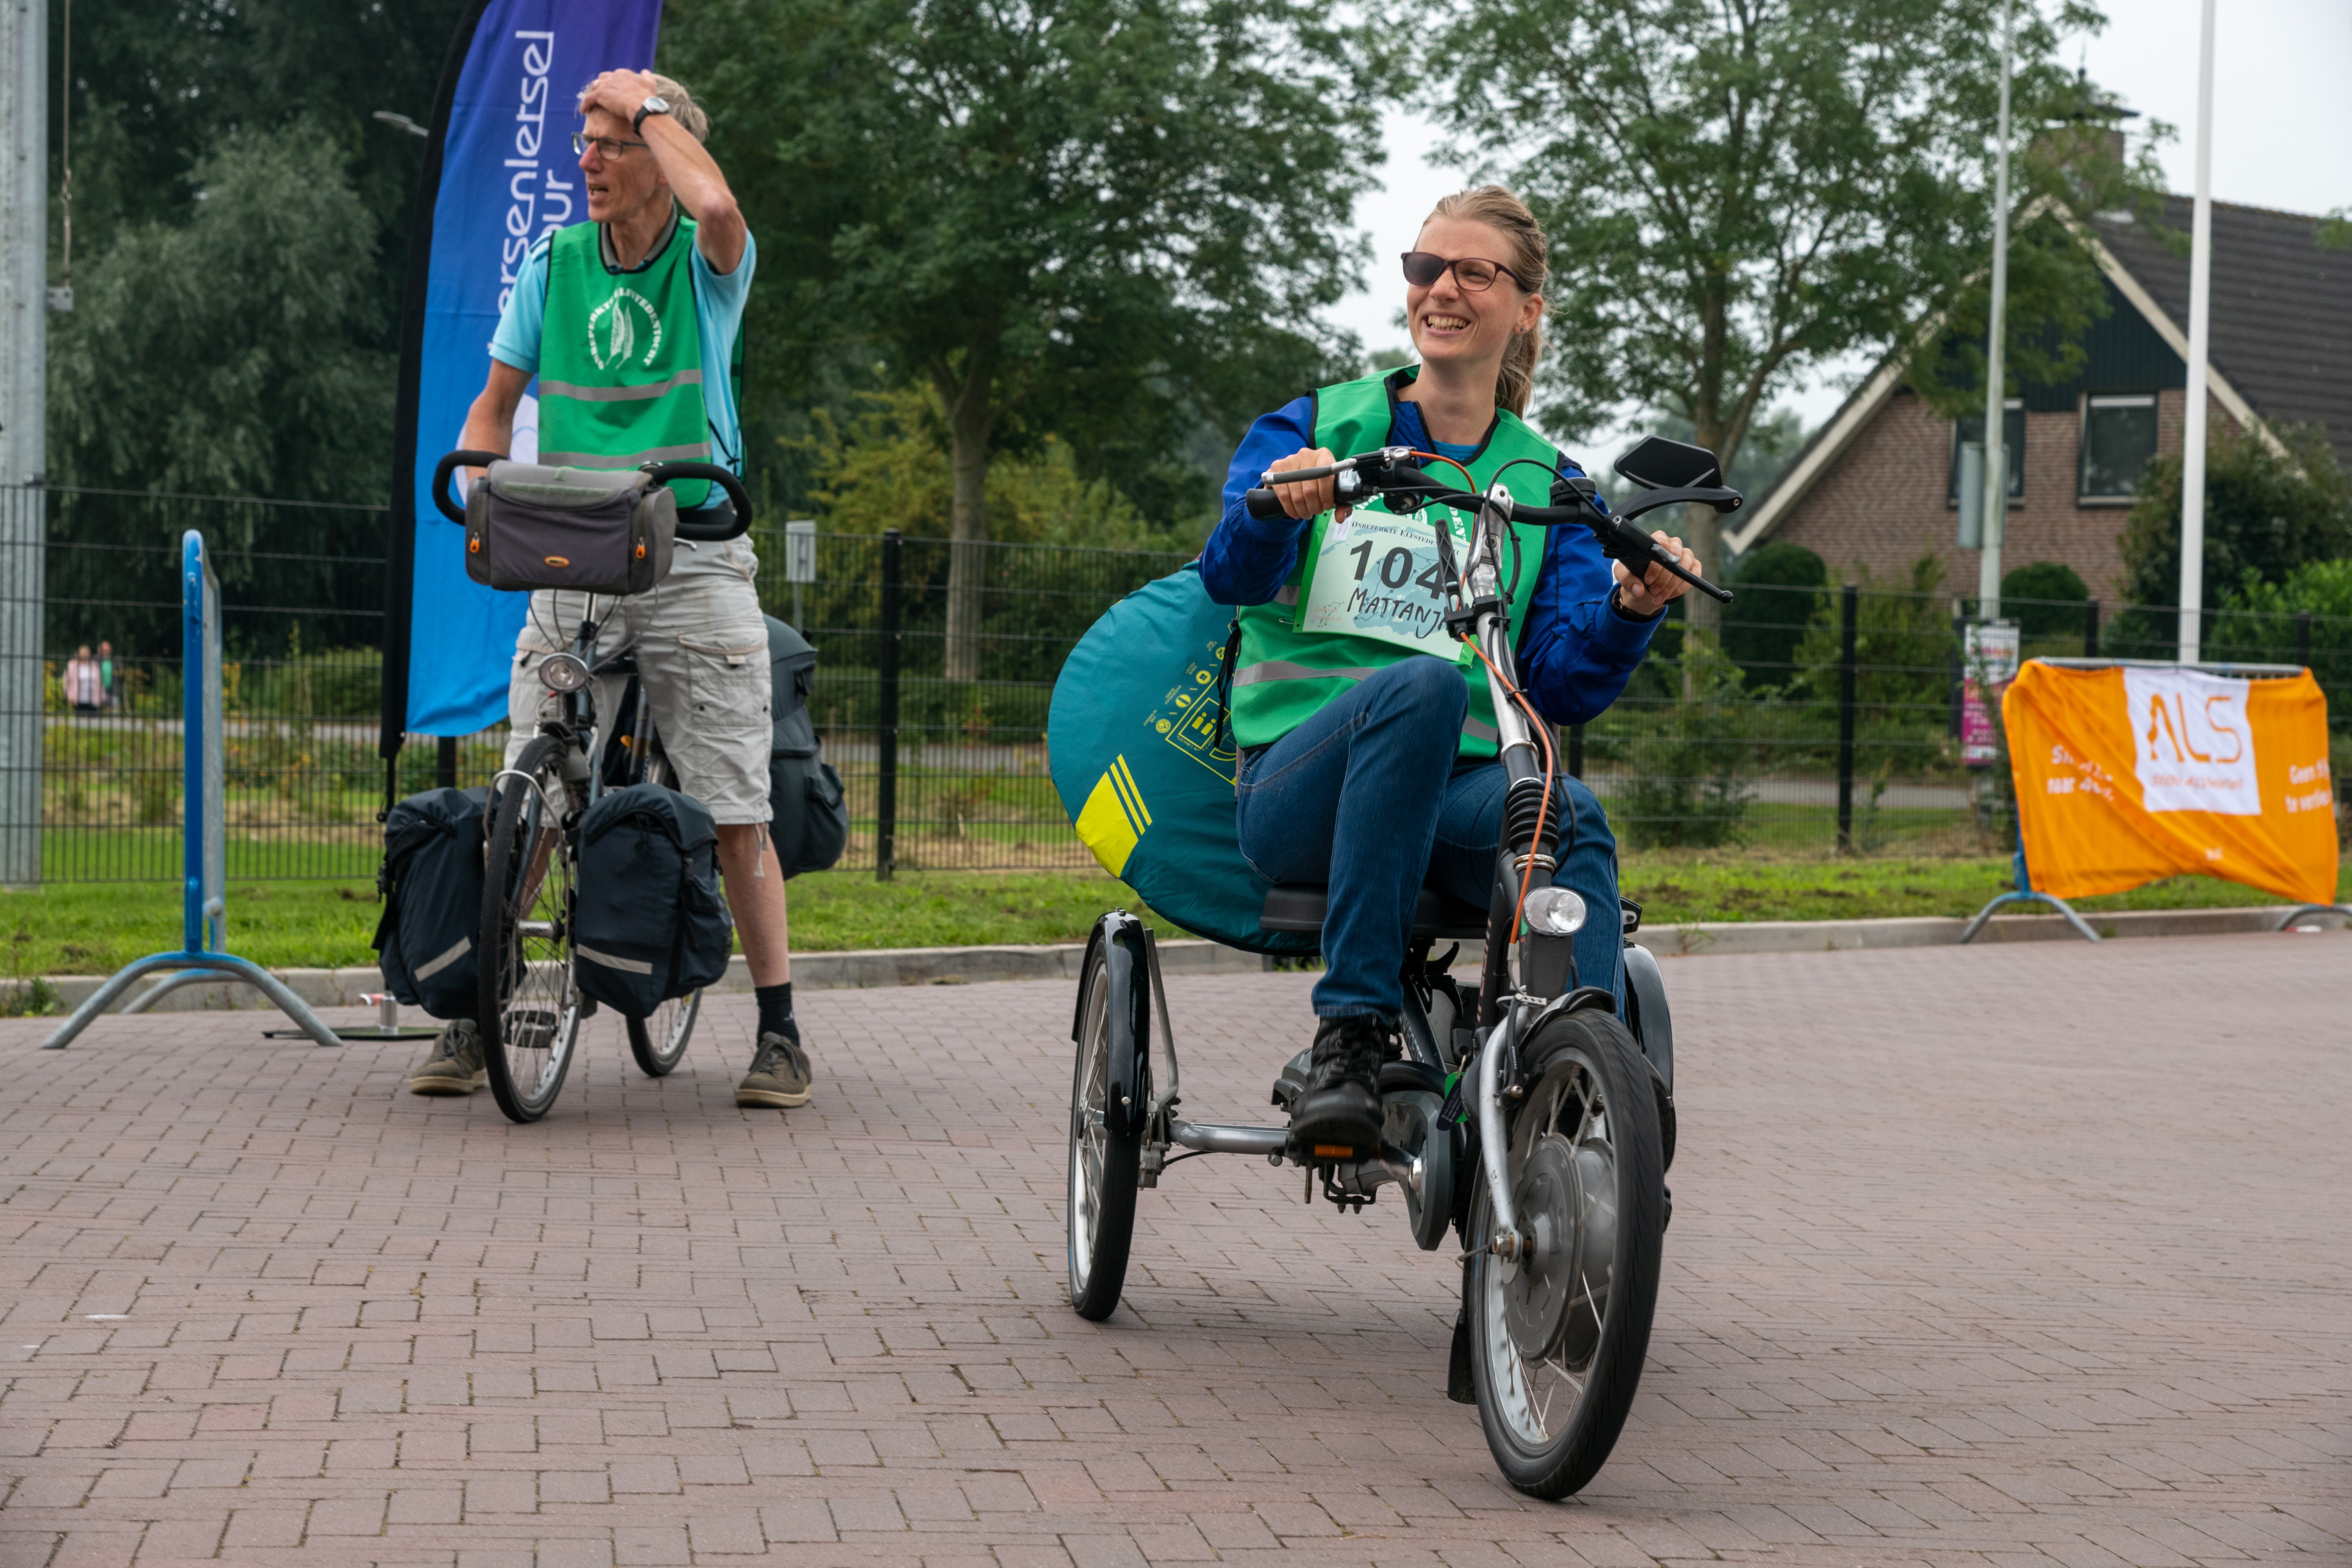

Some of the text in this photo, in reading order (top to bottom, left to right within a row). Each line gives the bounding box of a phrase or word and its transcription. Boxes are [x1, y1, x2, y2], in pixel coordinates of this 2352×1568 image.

[487, 30, 553, 352] ersenletsel
[1352, 521, 1398, 534] ONBEPERKTE
[1350, 540, 1445, 599] 104
[1185, 662, 1195, 674] POCKET
[2147, 692, 2243, 764] ALS
